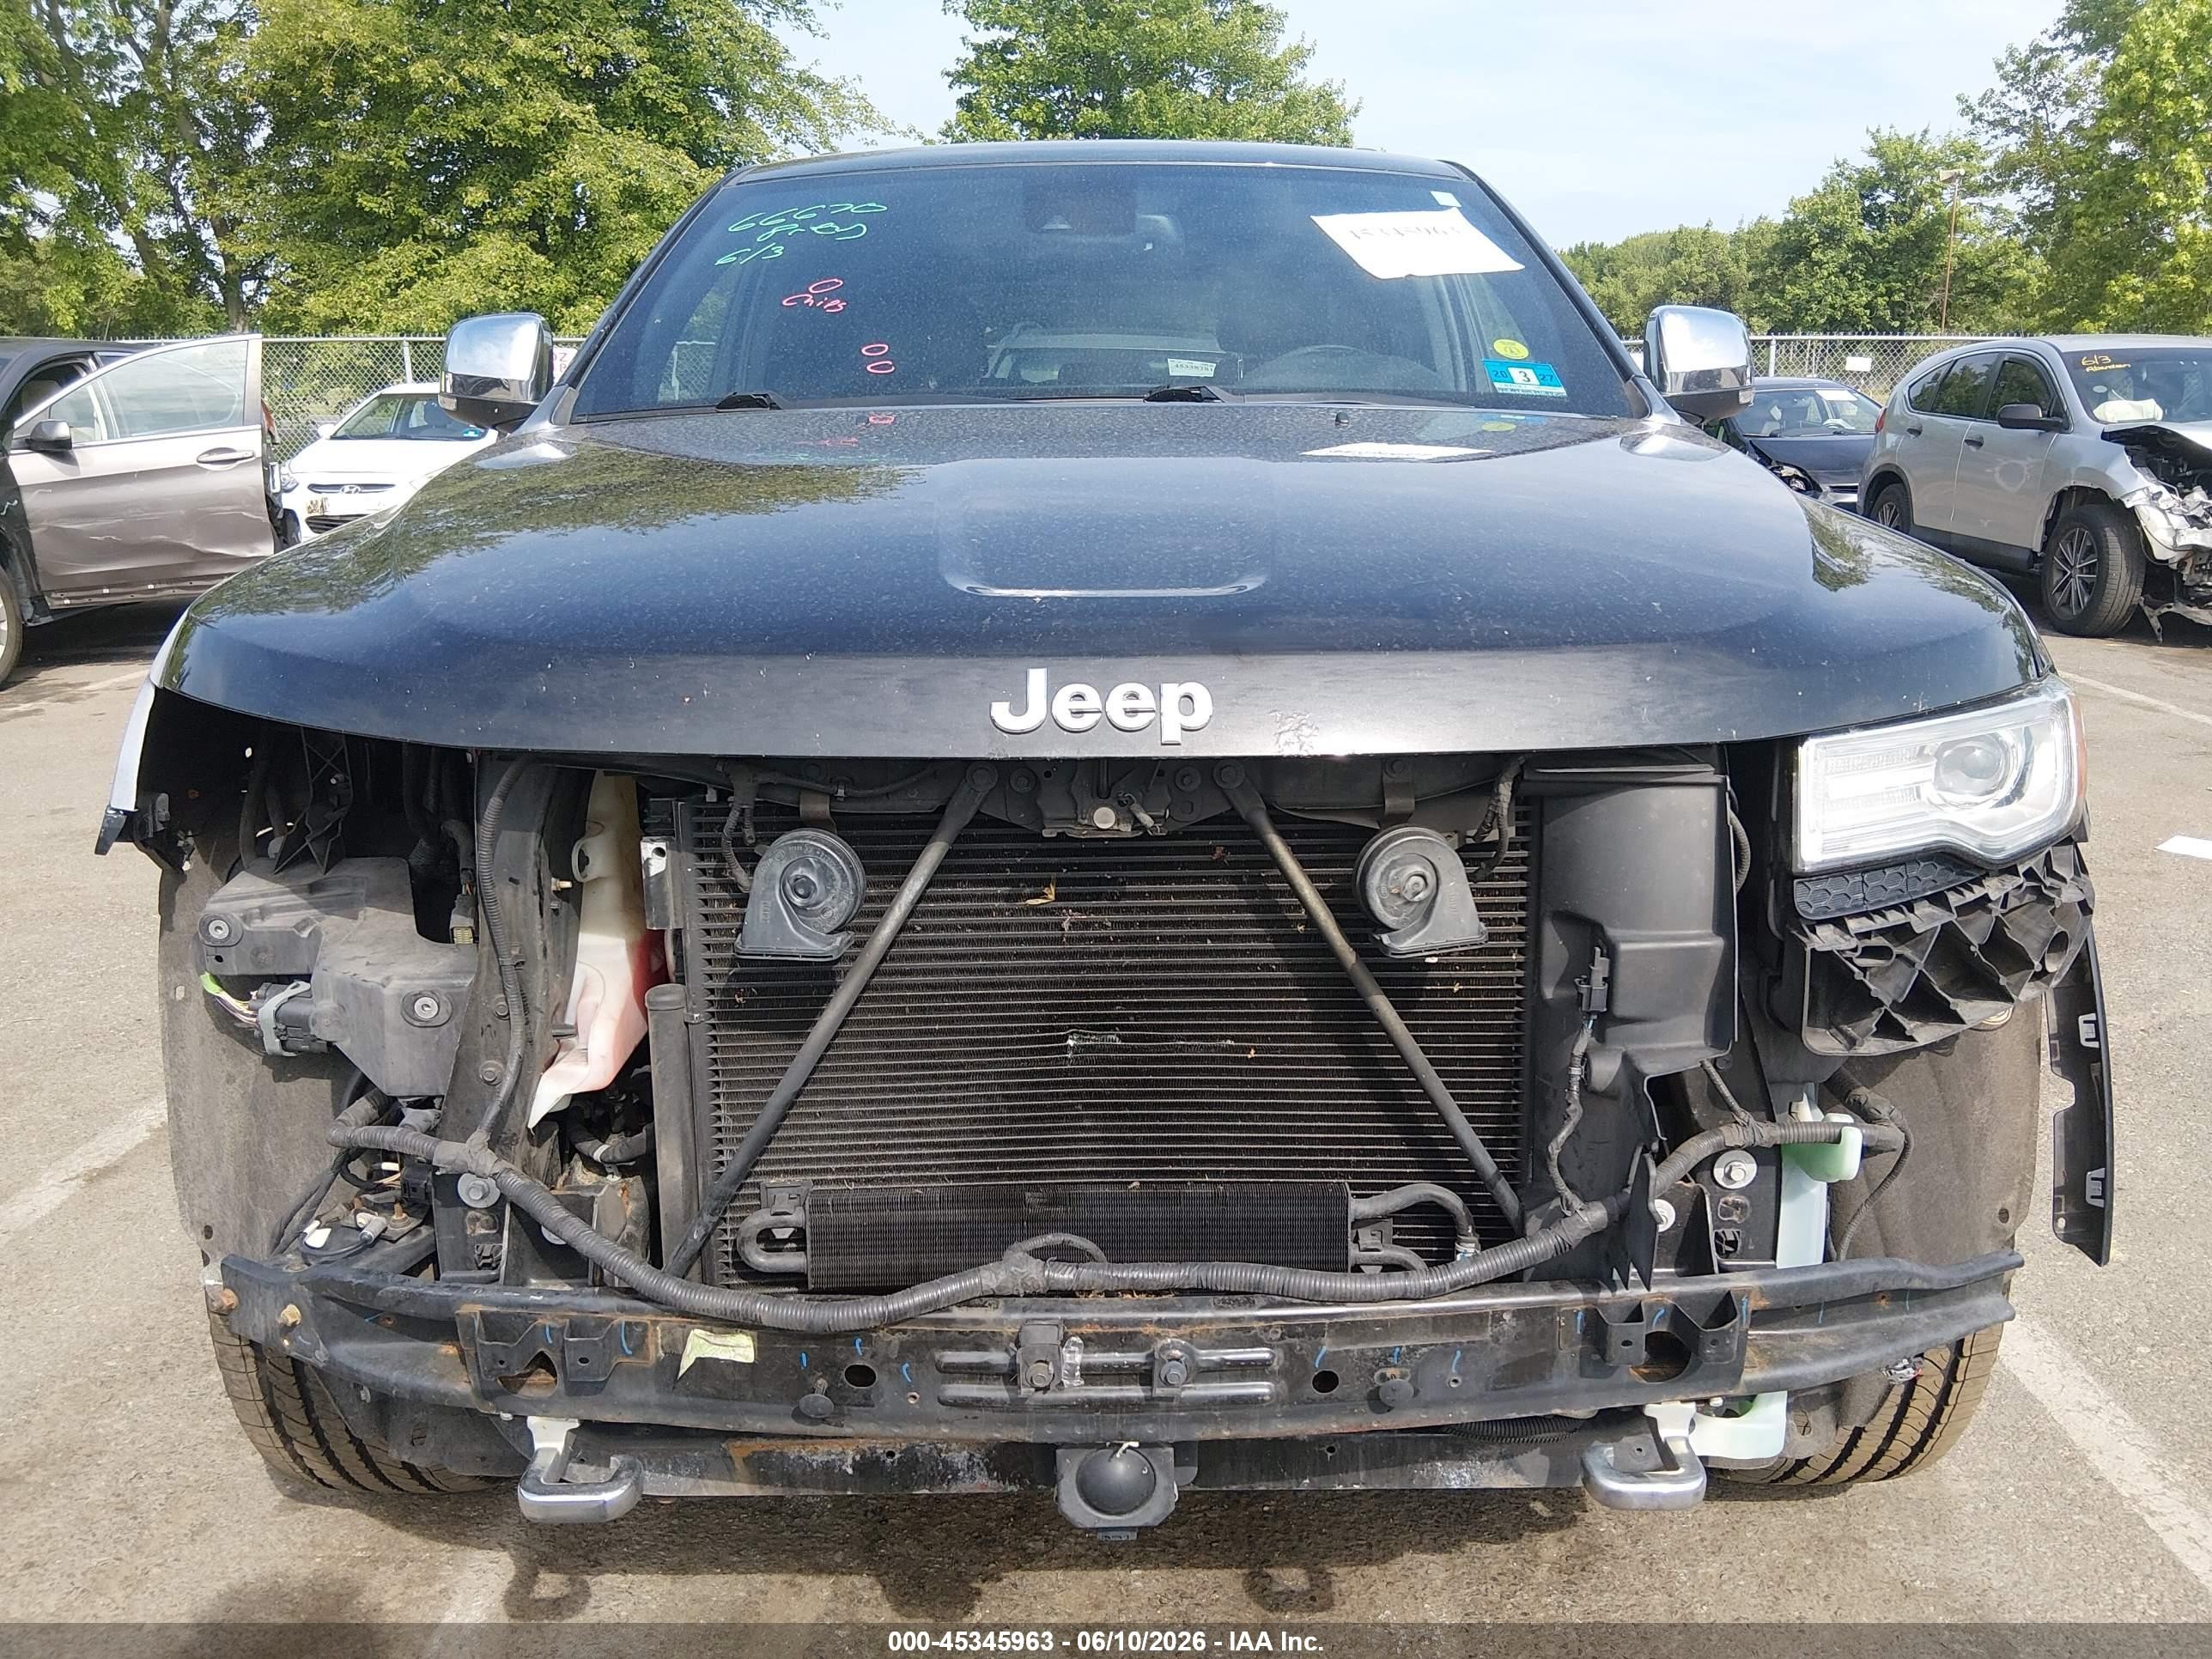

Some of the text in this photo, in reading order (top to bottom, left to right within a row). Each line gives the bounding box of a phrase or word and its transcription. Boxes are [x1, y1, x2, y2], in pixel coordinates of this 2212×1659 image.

[728, 203, 888, 232] 66670
[1492, 369, 1553, 383] 20 3 27
[990, 667, 1214, 746] Jeep
